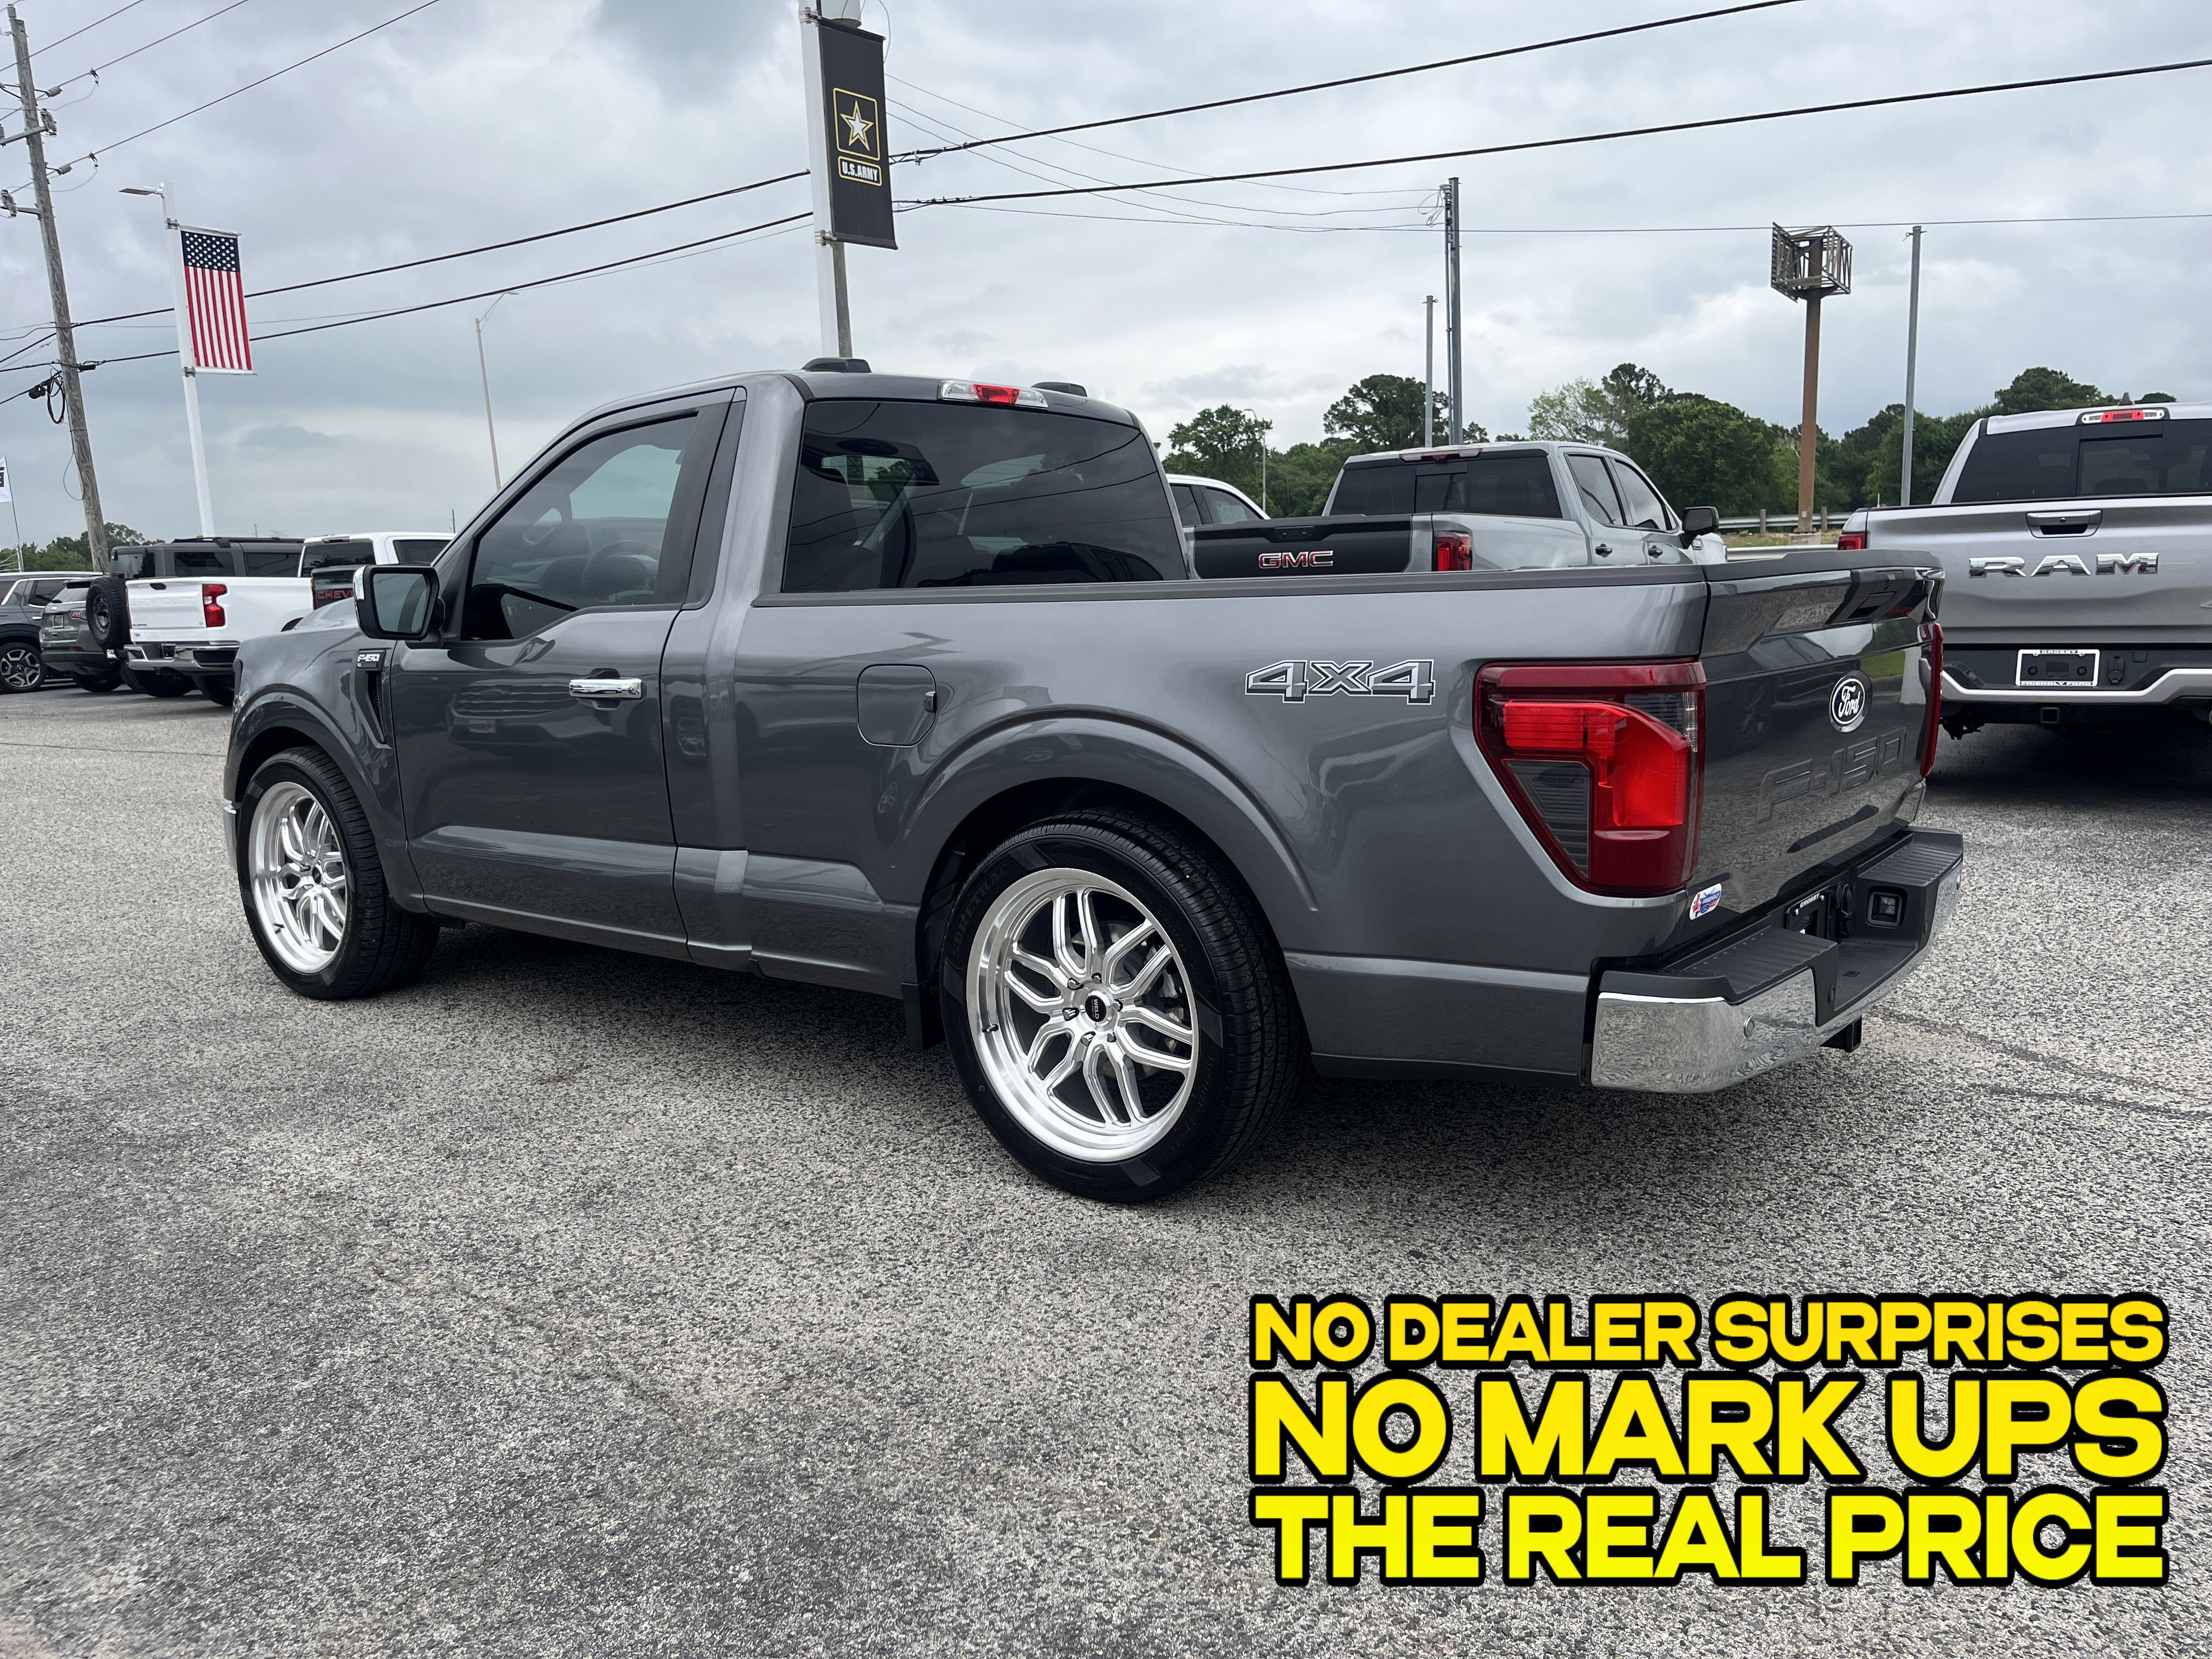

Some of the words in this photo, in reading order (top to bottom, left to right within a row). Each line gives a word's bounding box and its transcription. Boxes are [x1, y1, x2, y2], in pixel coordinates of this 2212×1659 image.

[1259, 550, 1333, 569] GMC
[1969, 552, 2159, 578] RAM
[317, 589, 354, 600] CHEV
[1838, 685, 1861, 718] Ford
[1757, 726, 1907, 824] F-150
[1799, 892, 1820, 908] CROSBY
